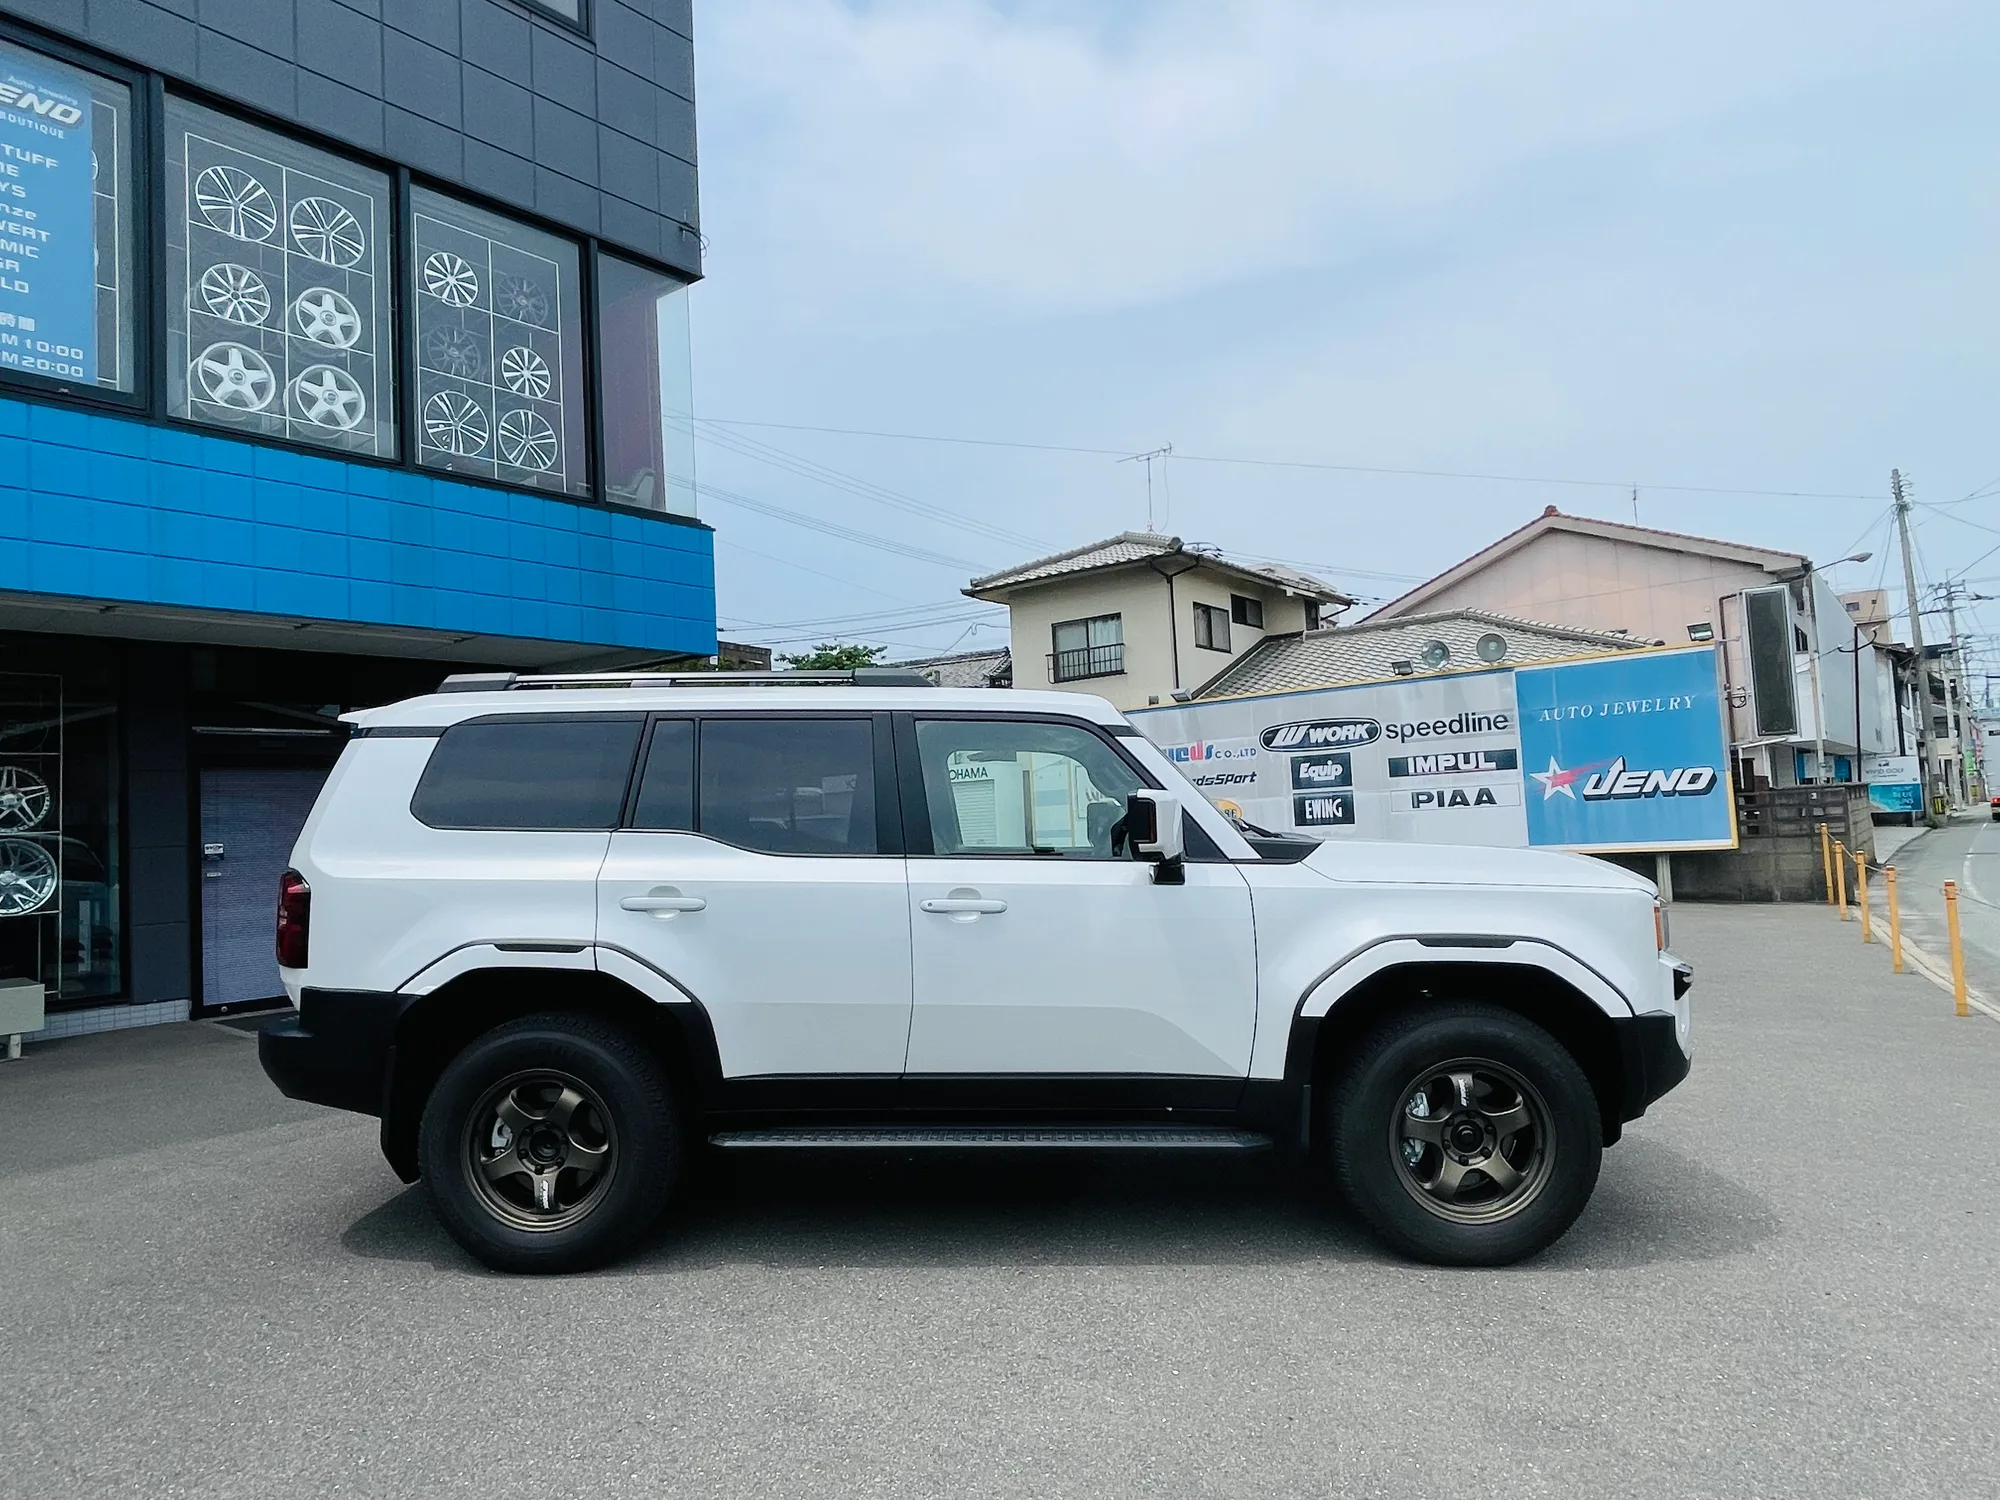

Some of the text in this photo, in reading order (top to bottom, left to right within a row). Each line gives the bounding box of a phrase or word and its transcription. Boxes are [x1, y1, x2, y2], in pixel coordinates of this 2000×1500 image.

[0, 143, 59, 169] TUFF
[22, 356, 84, 378] 20:00
[1539, 695, 1696, 722] AUTO JEWELRY
[1309, 723, 1371, 743] WORK
[1385, 712, 1508, 743] speedline
[1299, 760, 1343, 781] Equip
[1407, 752, 1496, 775] IMPUL
[1305, 799, 1342, 819] EWING
[1411, 788, 1497, 808] PIAA
